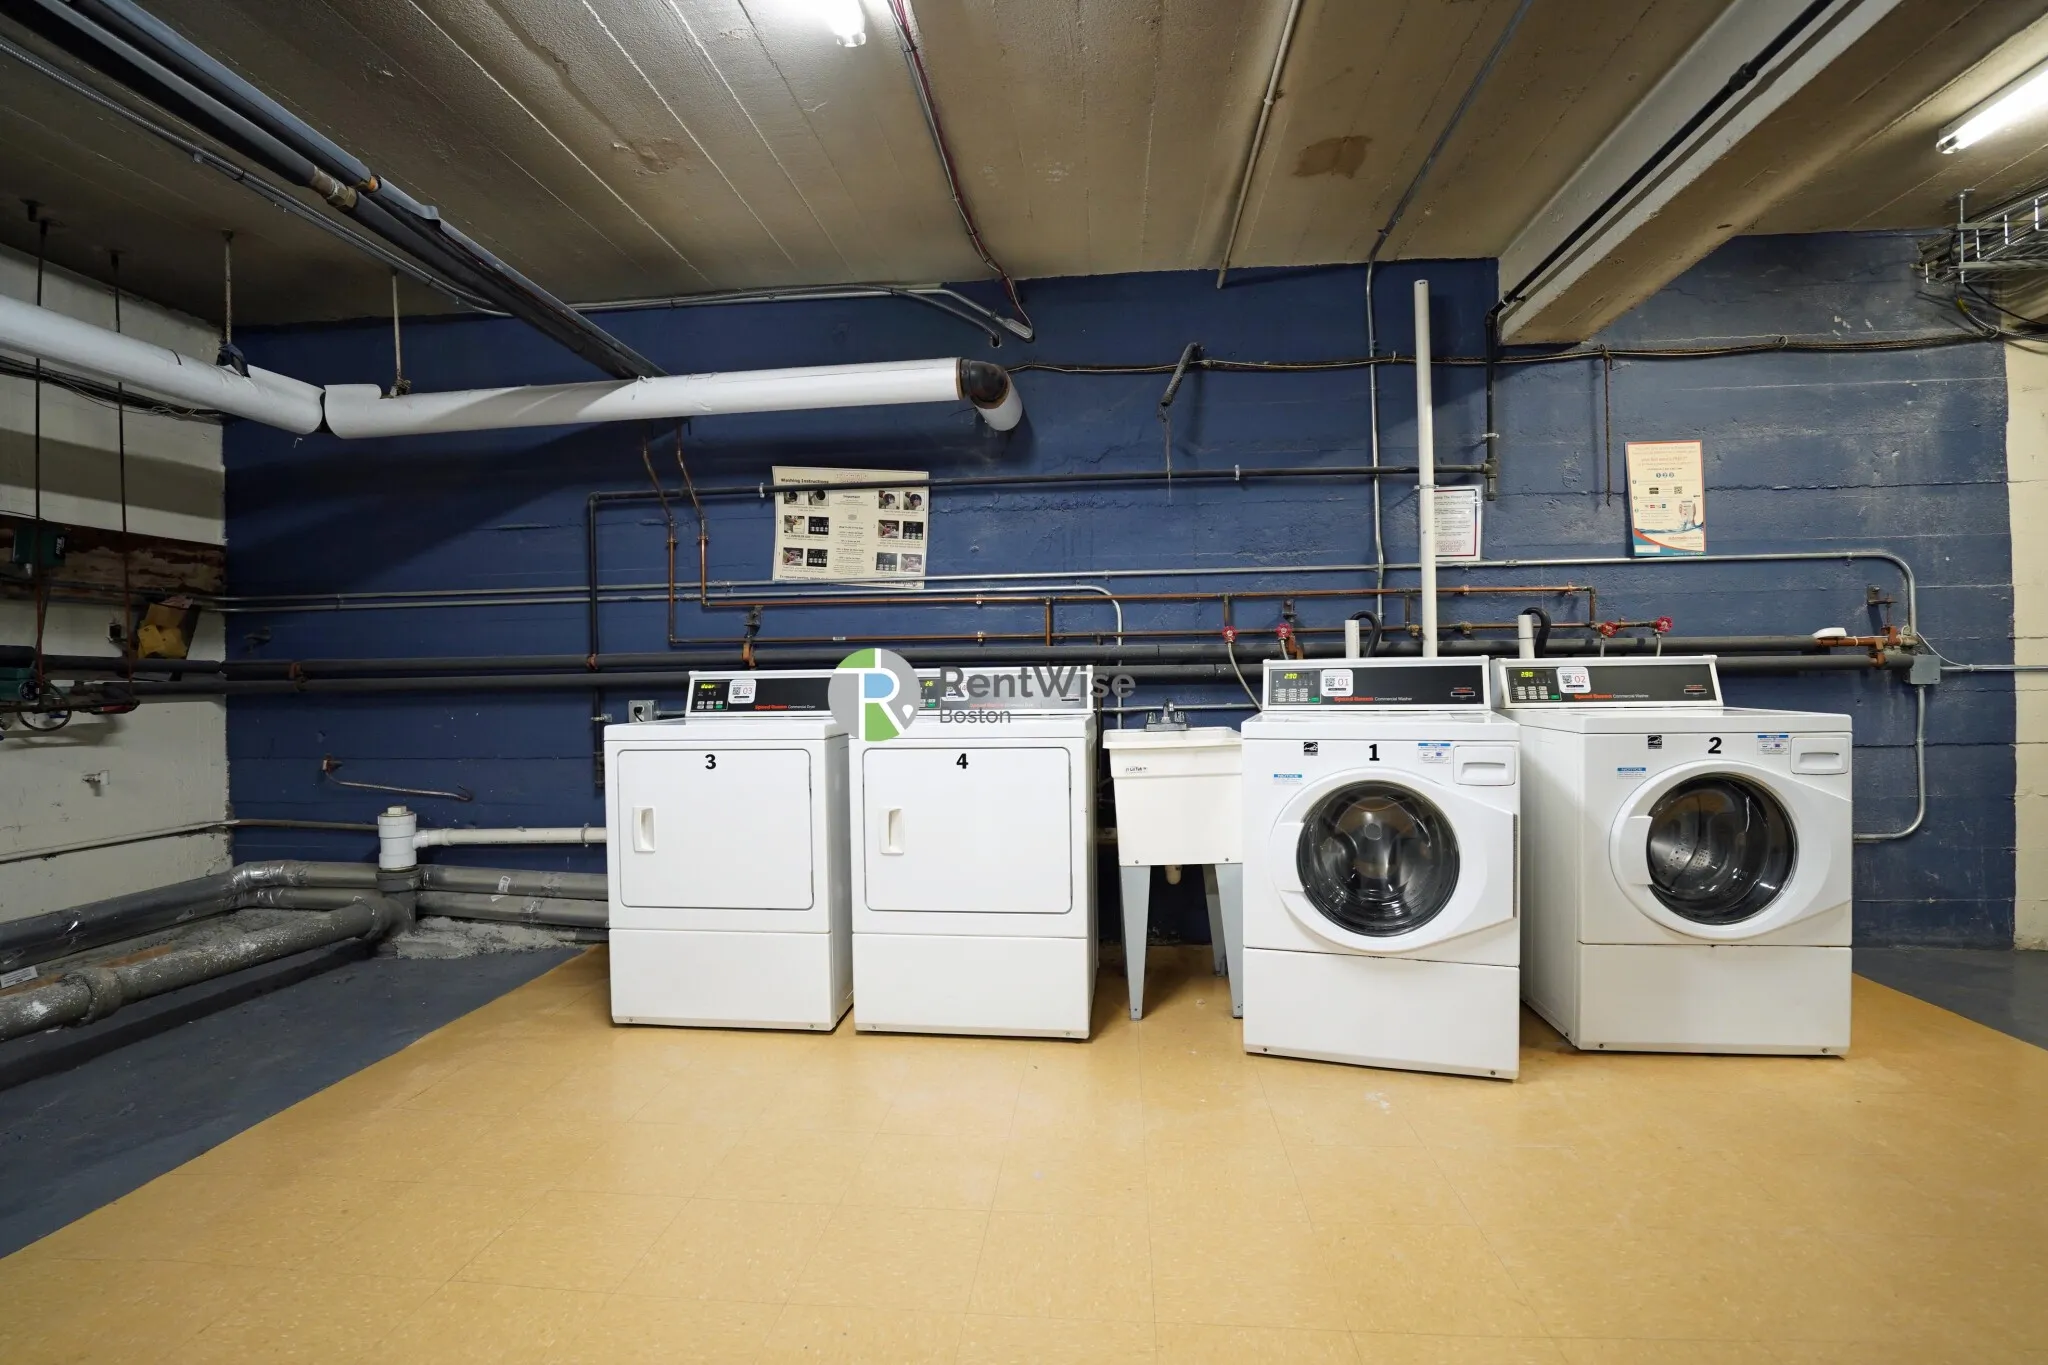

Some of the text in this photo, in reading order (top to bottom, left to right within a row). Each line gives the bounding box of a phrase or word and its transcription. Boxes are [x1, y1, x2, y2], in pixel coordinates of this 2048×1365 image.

[1337, 678, 1350, 687] 01
[1574, 675, 1586, 684] 02
[742, 687, 753, 695] 03
[1368, 743, 1380, 761] 1
[1707, 736, 1722, 754] 2
[704, 753, 717, 770] 3
[956, 753, 969, 770] 4
